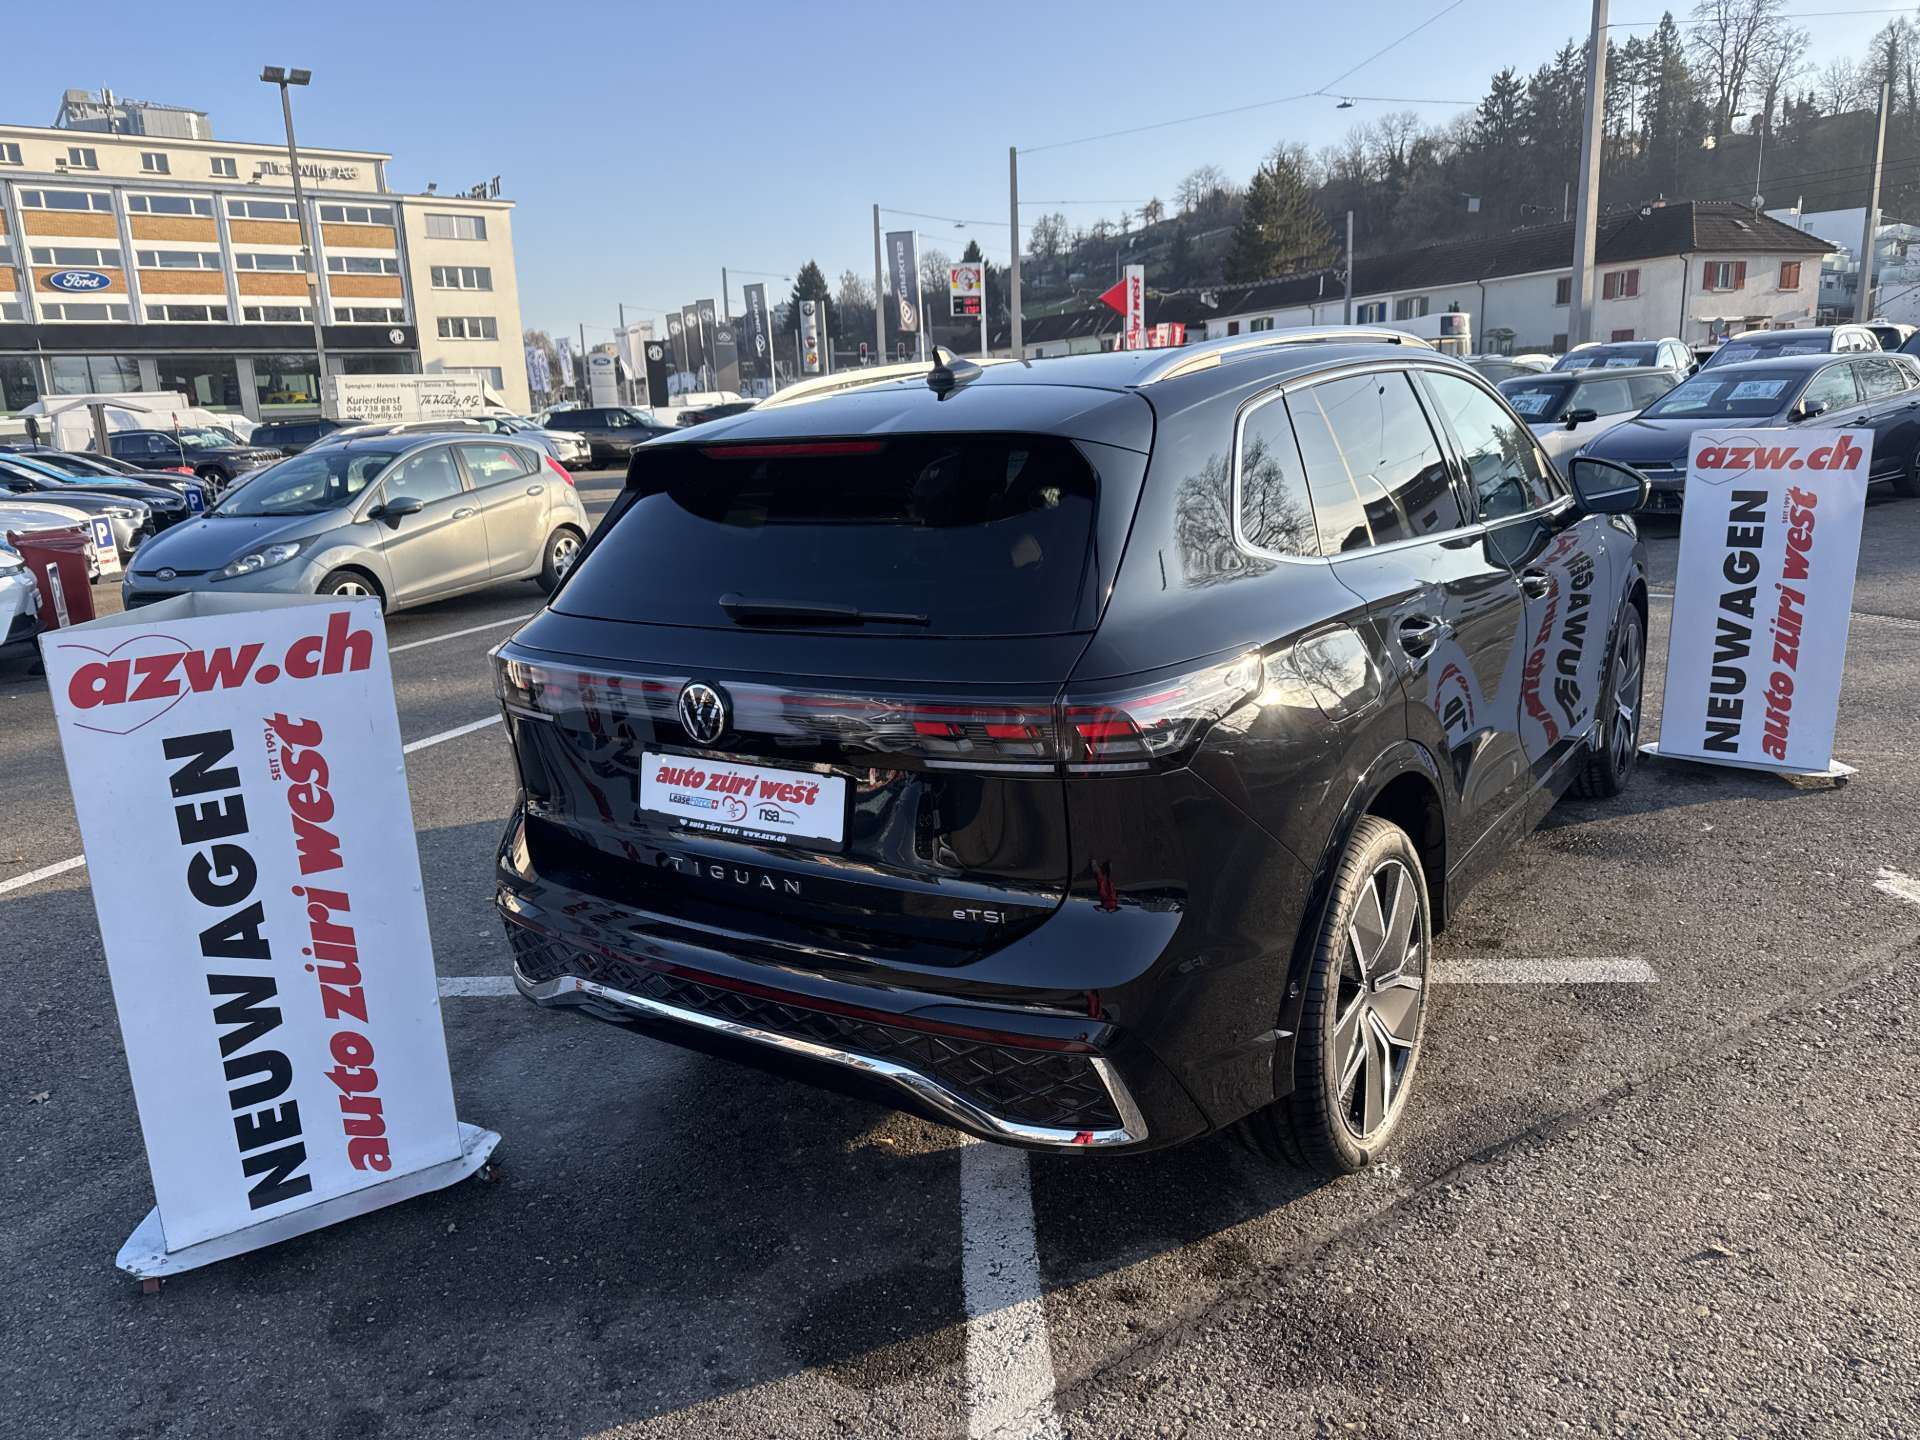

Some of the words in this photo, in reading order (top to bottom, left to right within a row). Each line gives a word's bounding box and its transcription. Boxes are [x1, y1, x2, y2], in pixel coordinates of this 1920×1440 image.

[62, 272, 100, 287] Ford
[346, 404, 361, 412] 044
[347, 396, 400, 405] Kurierdienst
[1695, 435, 1863, 470] azw.ch
[189, 494, 198, 507] P
[96, 522, 108, 545] P
[1782, 486, 1818, 580] west
[1703, 489, 1768, 754] NEUWAGEN
[1769, 582, 1806, 672] züri
[68, 611, 374, 710] azw.ch
[1762, 671, 1795, 761] auto
[269, 757, 282, 781] SEIT
[656, 765, 706, 788] auto
[705, 771, 759, 796] züri
[758, 780, 820, 806] west
[263, 712, 344, 875] west
[759, 808, 780, 822] nsa
[669, 856, 801, 895] TIGUAN
[953, 908, 1006, 924] eTSI
[162, 728, 313, 1211] NEUWAGEN
[292, 885, 369, 1024] züri
[323, 1031, 392, 1172] auto
